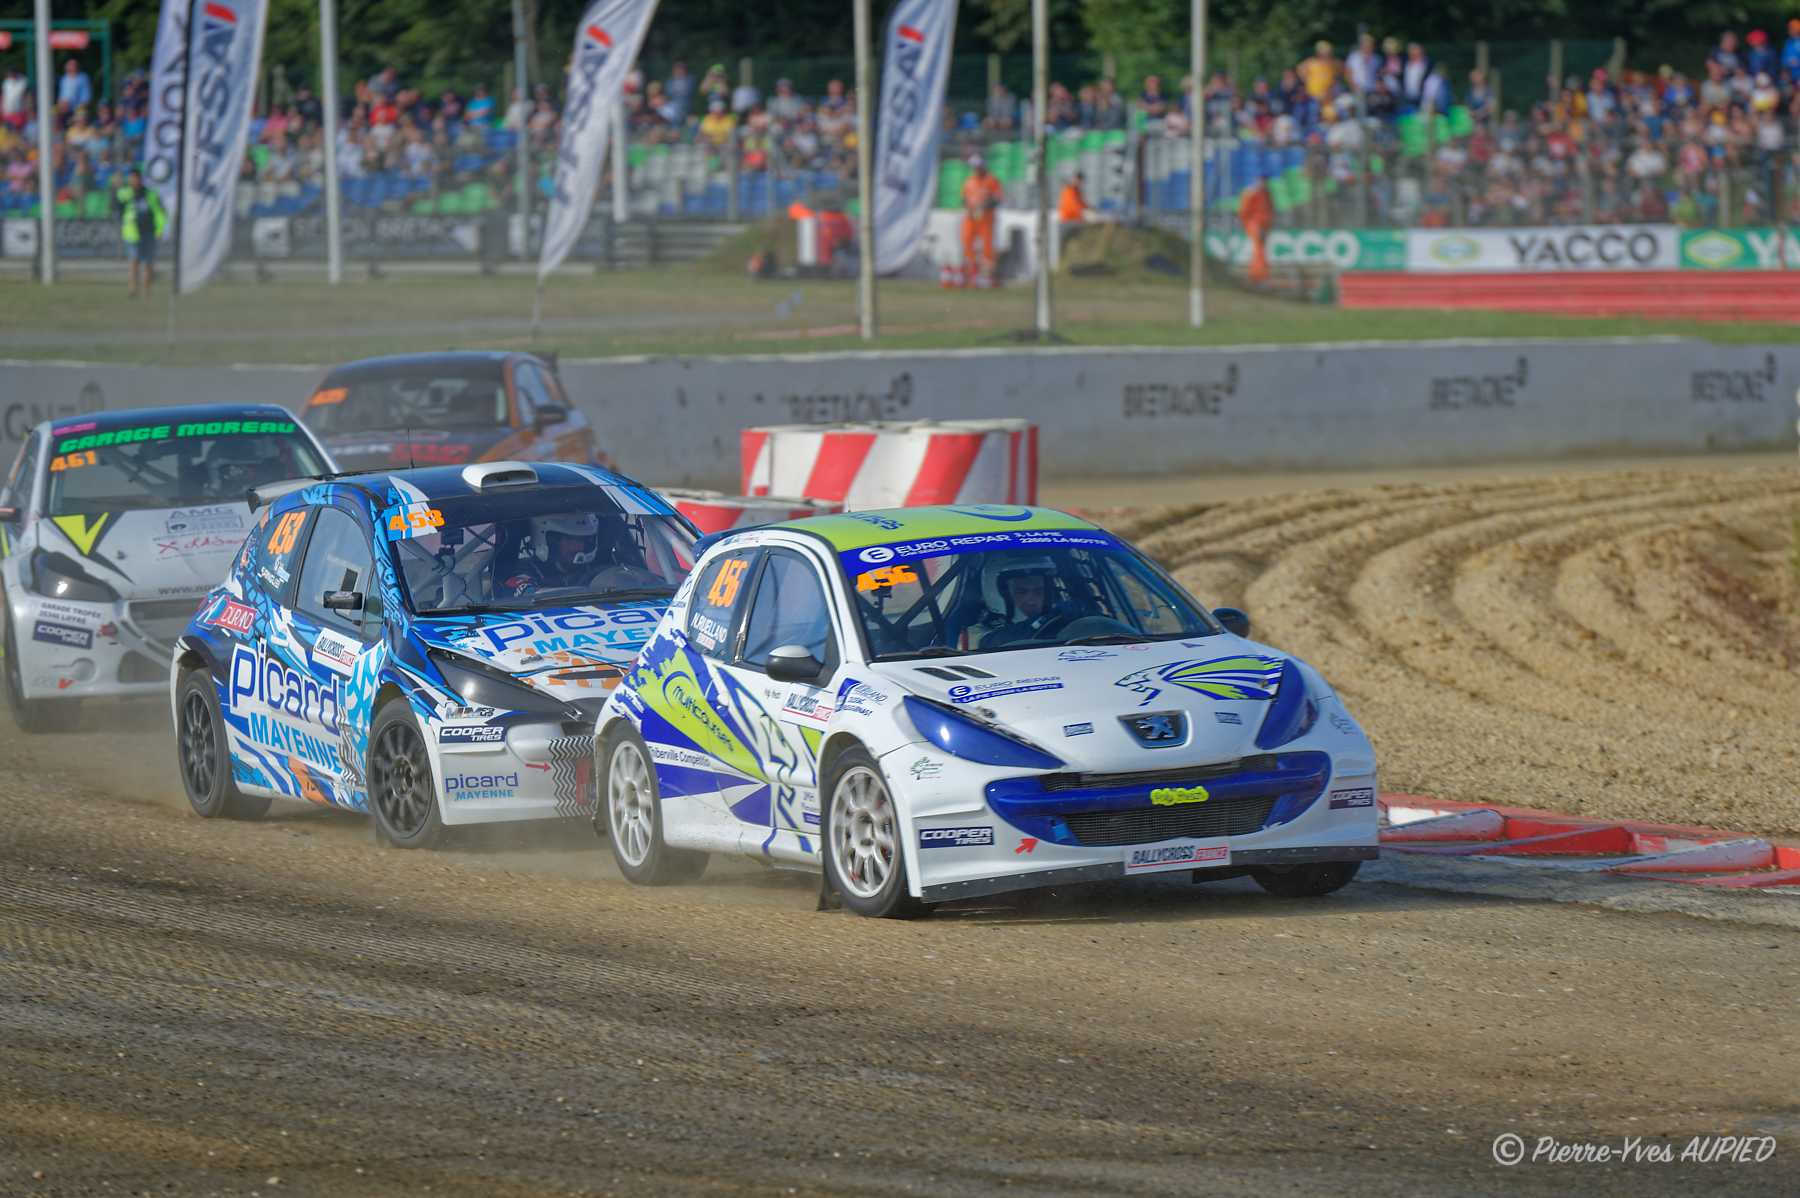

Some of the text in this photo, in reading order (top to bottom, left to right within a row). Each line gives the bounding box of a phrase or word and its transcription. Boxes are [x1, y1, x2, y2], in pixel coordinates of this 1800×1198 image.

[1508, 230, 1661, 264] YACCO
[59, 425, 170, 453] GARAGE
[177, 420, 297, 437] MOREAU
[50, 451, 96, 472] 461
[390, 509, 445, 531] 453
[267, 511, 306, 555] 453
[895, 533, 1012, 555] EURO REPAR
[532, 627, 657, 654] MAYE
[233, 642, 340, 737] picard
[440, 726, 504, 736] COOPER
[250, 712, 343, 775] MAYENNE
[445, 772, 519, 793] picard
[456, 789, 514, 801] MAYENNE
[1331, 789, 1371, 802] COOPER
[920, 828, 992, 841] COOPER
[1130, 844, 1195, 865] RALLYCROSS
